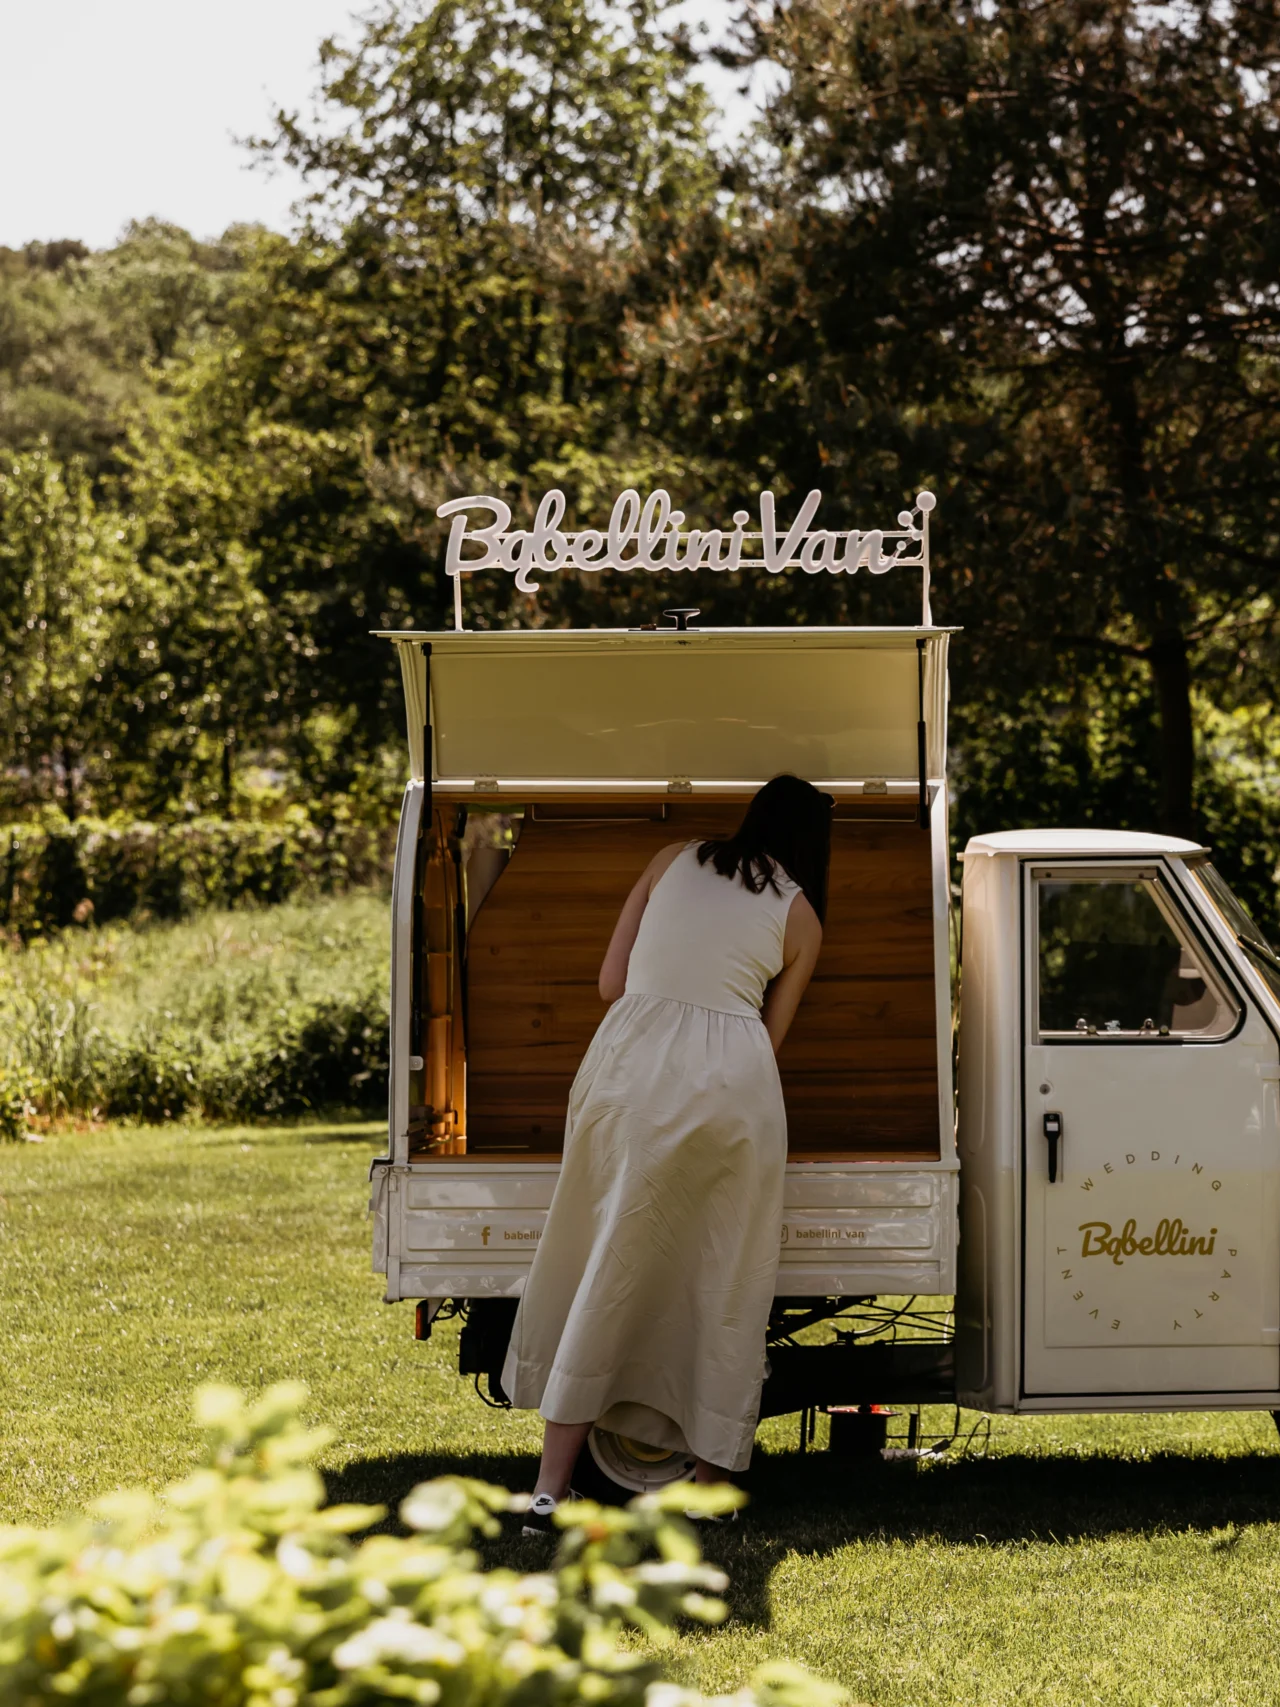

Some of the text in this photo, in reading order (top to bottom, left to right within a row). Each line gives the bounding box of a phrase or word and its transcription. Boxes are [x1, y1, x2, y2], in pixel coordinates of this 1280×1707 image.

[760, 488, 895, 574] Van
[1080, 1151, 1222, 1192] WEDDING
[1056, 1246, 1121, 1330] EVENT
[1172, 1248, 1238, 1331] PARTY
